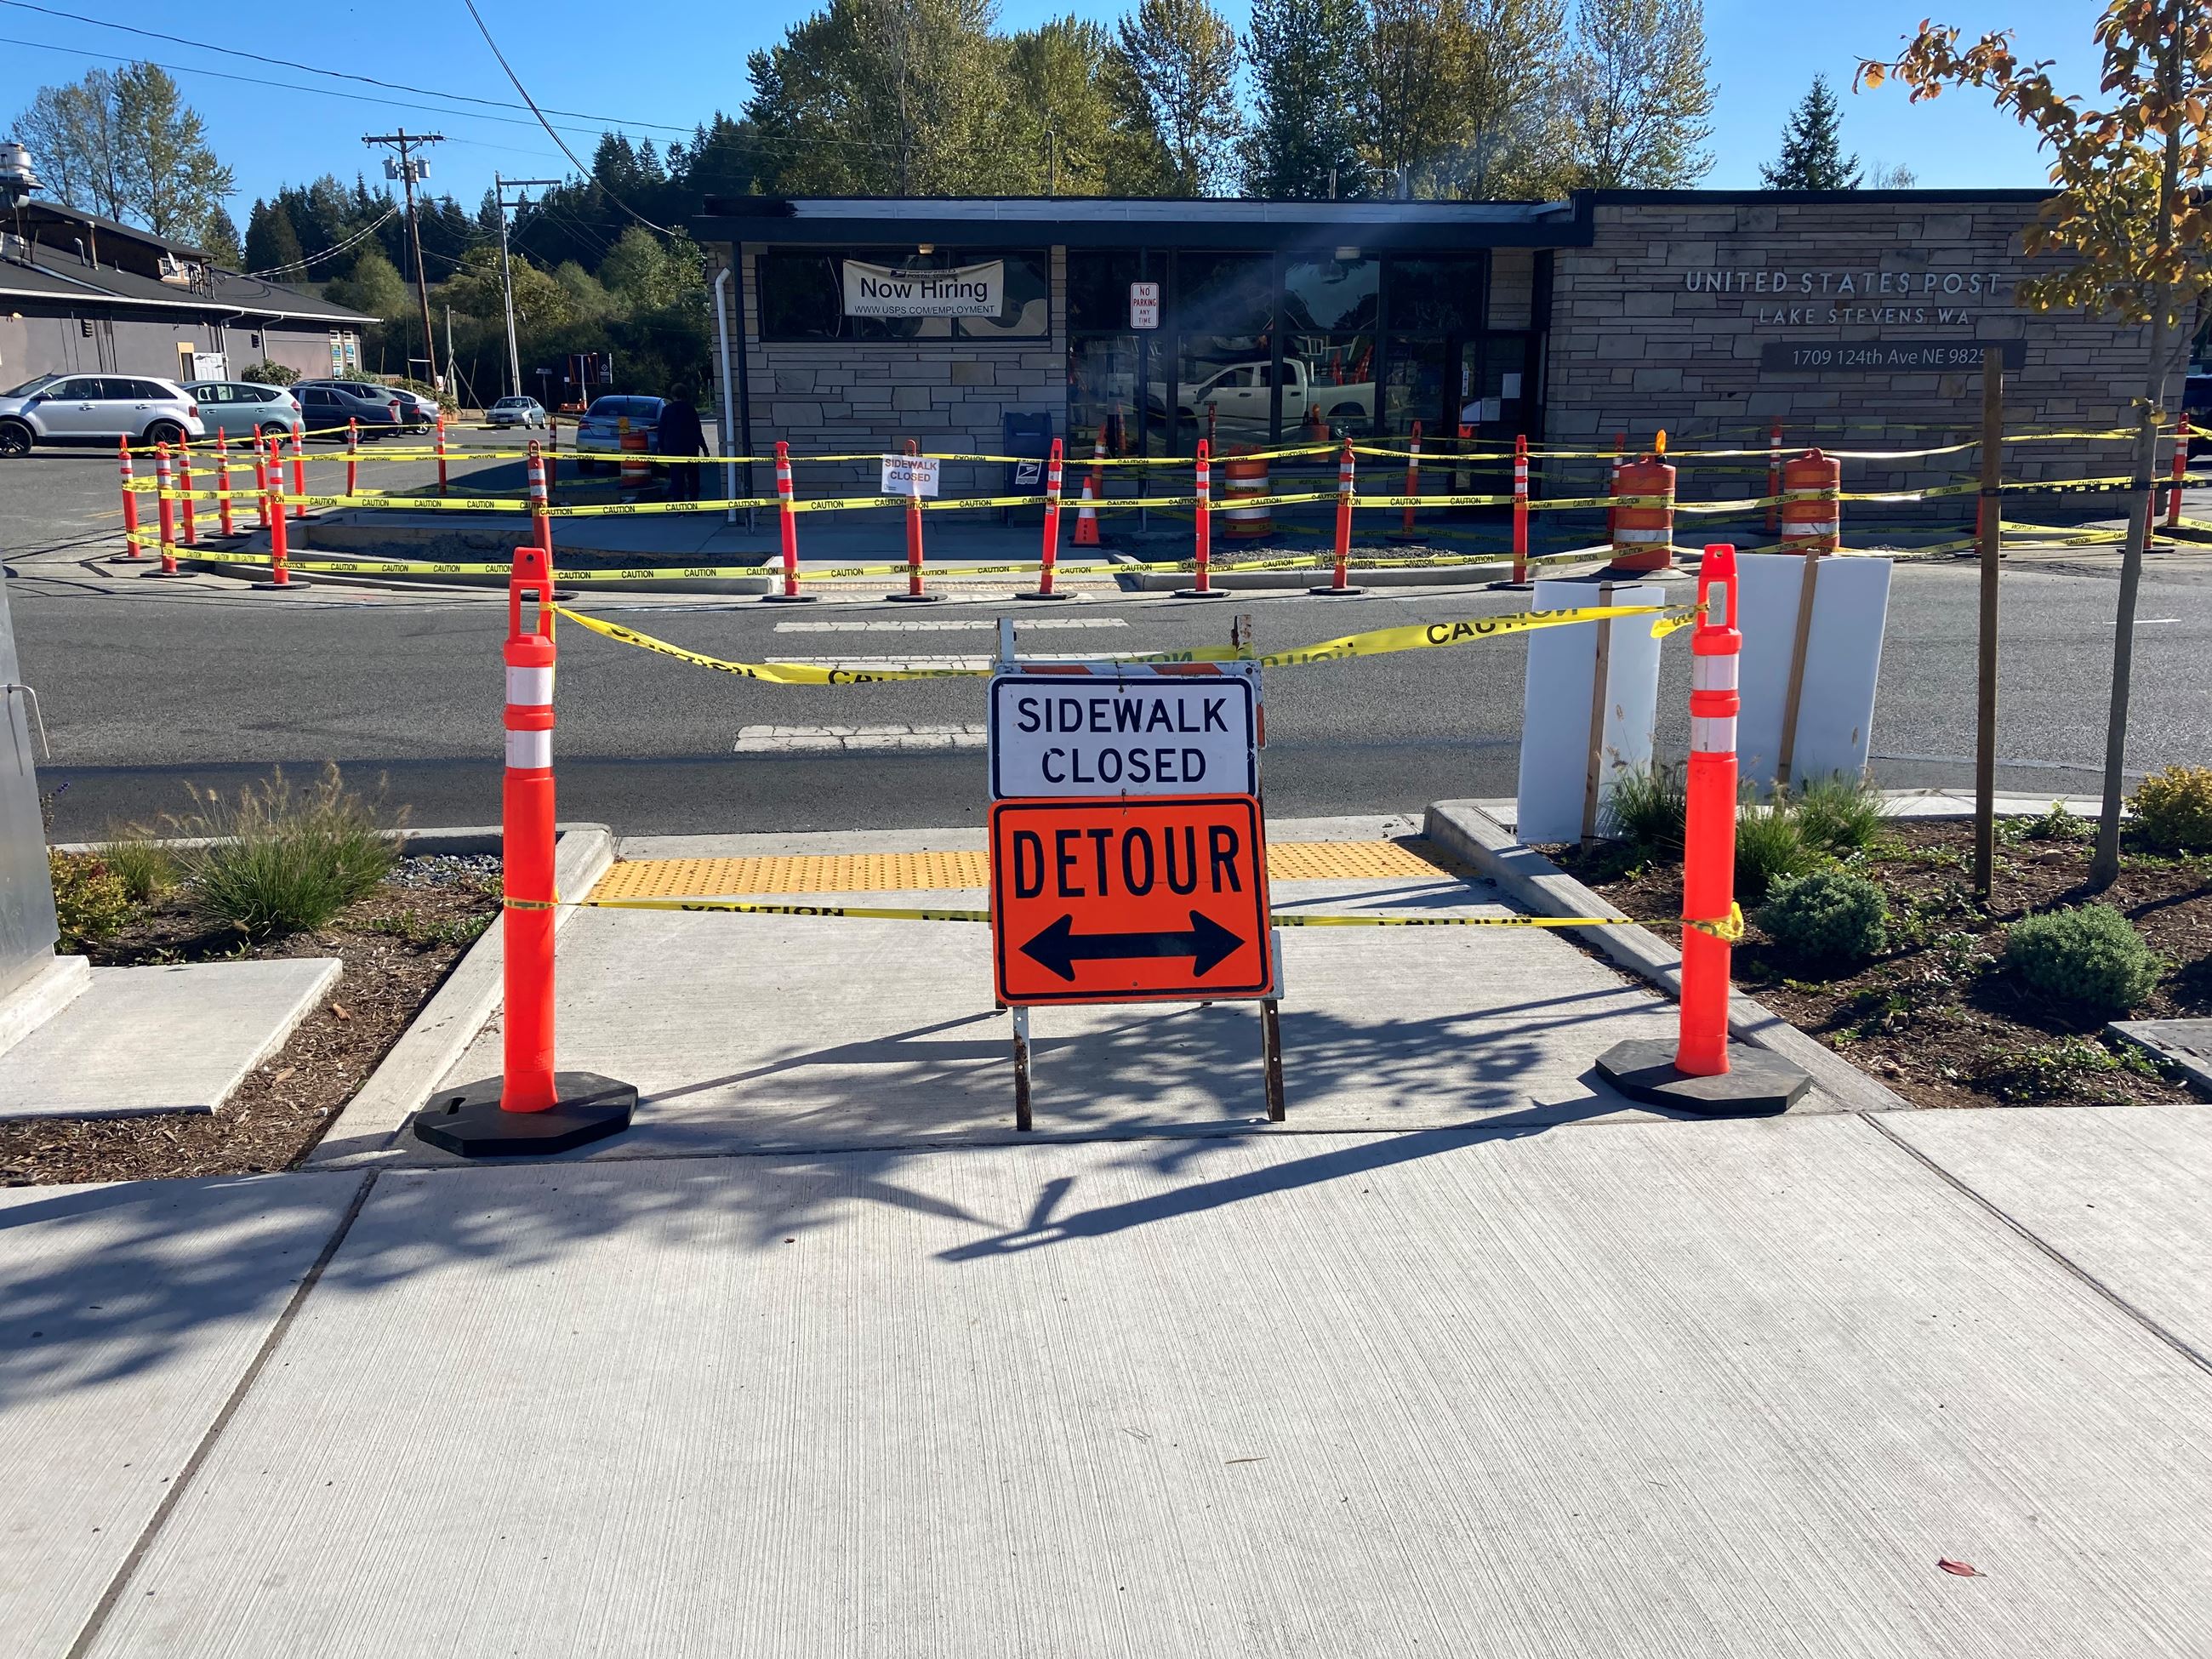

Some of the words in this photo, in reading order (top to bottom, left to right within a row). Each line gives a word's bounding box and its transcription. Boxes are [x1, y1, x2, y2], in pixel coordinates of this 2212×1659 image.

[1685, 271, 1787, 293] UNITED
[1800, 272, 1910, 294] STATES
[1924, 272, 2001, 294] POST
[861, 277, 912, 299] Now
[921, 278, 988, 303] Hiring
[1140, 286, 1150, 296] NO
[1133, 298, 1157, 307] PARKING
[854, 305, 995, 315] WWW.USPS.COM/EMPLOYMENT
[1759, 307, 1816, 324] LAKE
[1828, 307, 1925, 325] STEVENS
[1938, 309, 1970, 325] WA
[1793, 350, 1832, 366] 1709
[1838, 349, 1883, 365] 124th
[1888, 349, 1918, 365] Ave
[1924, 349, 1946, 365] NE
[1949, 348, 1985, 364] 9825
[885, 458, 937, 471] SIDEWALK
[890, 471, 931, 482] CLOSED
[310, 498, 337, 506] CAUTION
[362, 499, 389, 507] CAUTION
[414, 499, 442, 508] CAUTION
[467, 500, 494, 509] CAUTION
[811, 500, 844, 509] CAUTION
[874, 499, 907, 507] CAUTION
[960, 499, 992, 508] CAUTION
[1250, 498, 1282, 506] CAUTION
[1390, 498, 1422, 506] CAUTION
[1450, 497, 1482, 505] CAUTION
[1573, 499, 1596, 507] CAUTION
[603, 505, 636, 514] CAUTION
[665, 503, 698, 511] CAUTION
[2066, 536, 2091, 545] CAUTION
[1262, 559, 1294, 569] CAUTION
[1463, 555, 1495, 564] CAUTION
[331, 563, 358, 572] CAUTION
[382, 564, 409, 573] CAUTION
[433, 564, 461, 573] CAUTION
[621, 570, 654, 579] CAUTION
[684, 568, 716, 577] CAUTION
[746, 567, 778, 576] CAUTION
[831, 568, 864, 578] CAUTION
[1120, 564, 1152, 572] CAUTION
[1018, 697, 1229, 733] SIDEWALK
[1042, 747, 1206, 784] CLOSED
[1012, 824, 1243, 899] DETOUR
